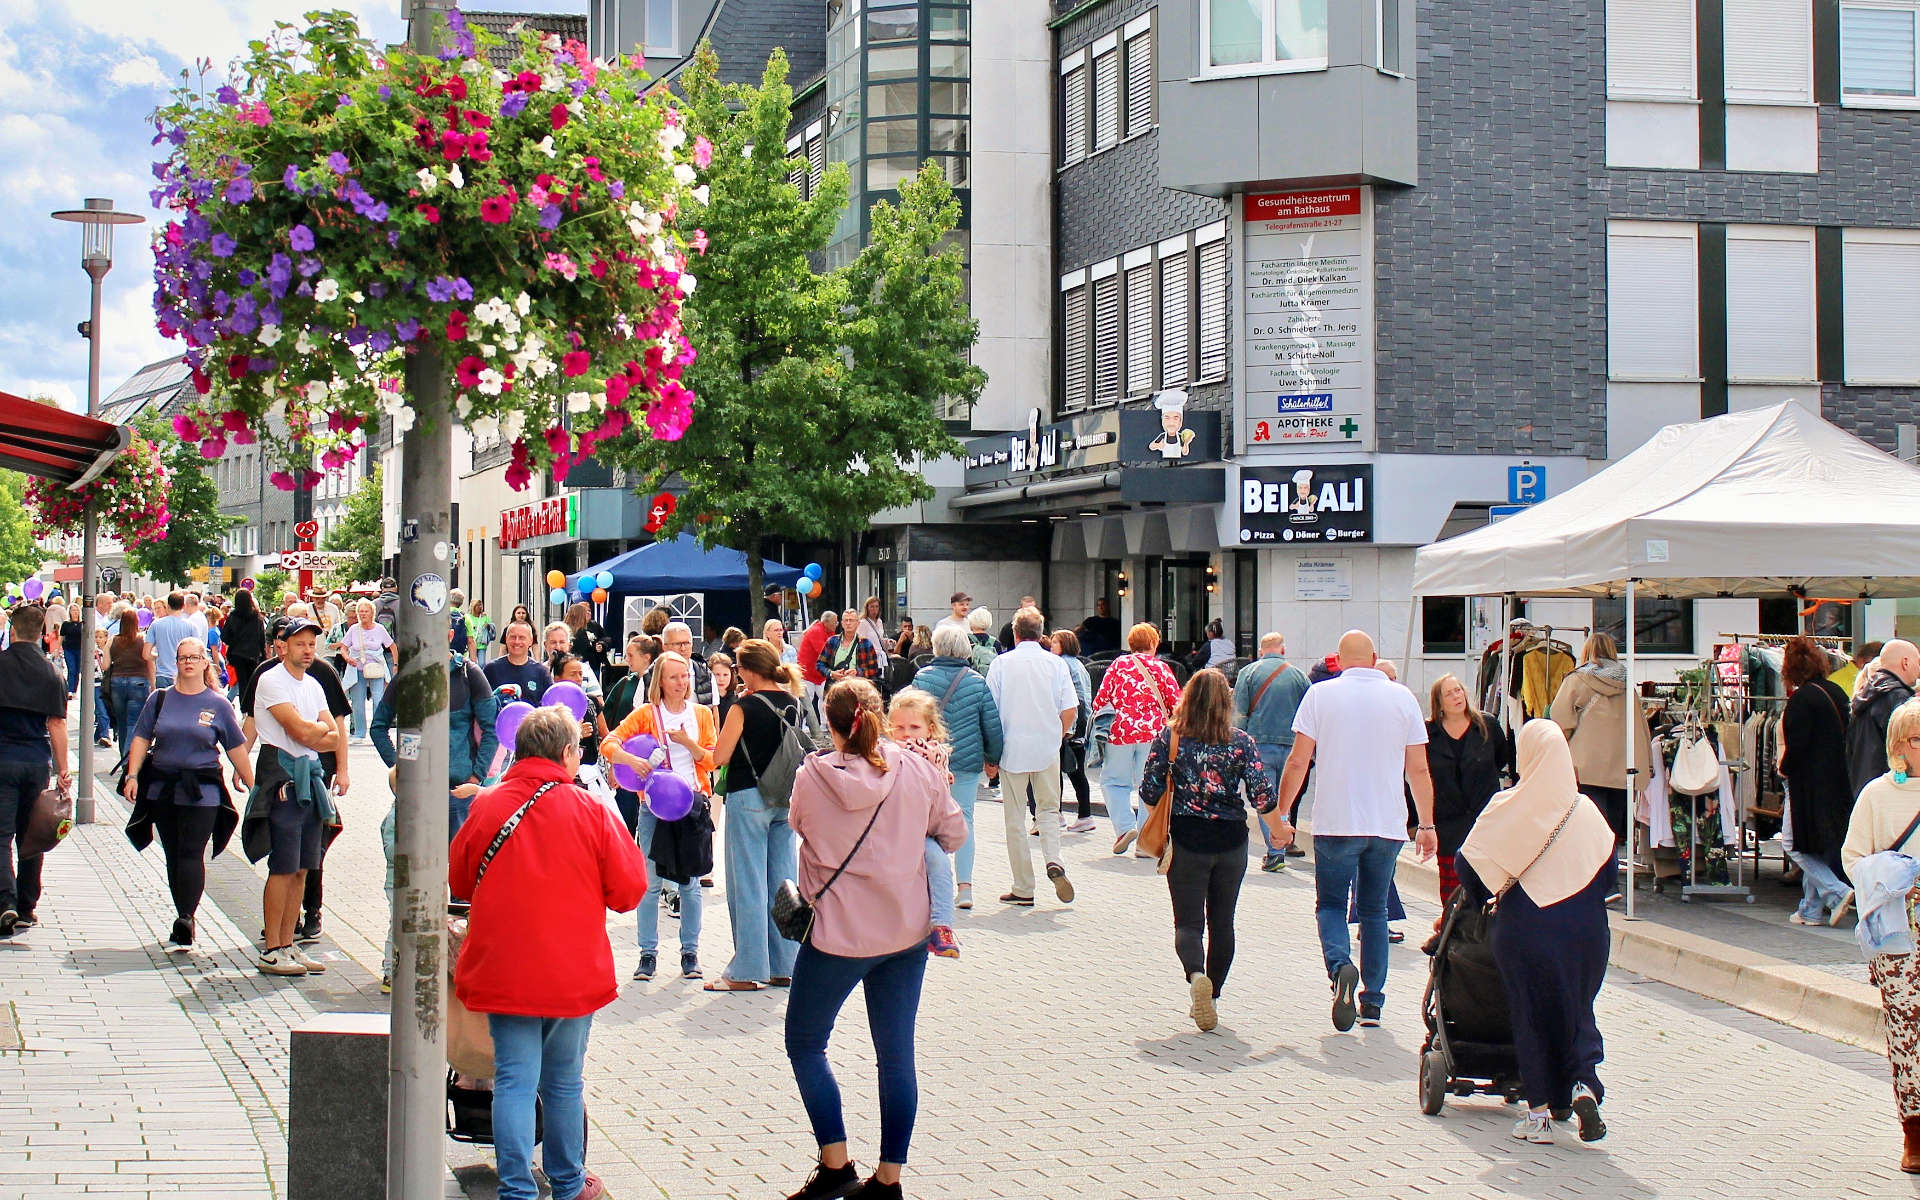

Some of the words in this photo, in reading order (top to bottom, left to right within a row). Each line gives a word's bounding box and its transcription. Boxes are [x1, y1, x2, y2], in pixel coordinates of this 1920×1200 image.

[1257, 194, 1350, 207] Gesundheitszentrum
[1277, 208, 1292, 216] am
[1294, 205, 1331, 215] Rathaus
[1265, 221, 1322, 231] Telegrafenstraße
[1324, 219, 1342, 227] 21-27
[1262, 277, 1274, 286] Dr.
[1297, 275, 1318, 284] Dilek
[1319, 274, 1347, 283] Kalkan
[1279, 300, 1299, 308] Jutta
[1253, 327, 1265, 335] Dr.
[1323, 324, 1336, 332] Th.
[1326, 341, 1356, 350] Massage
[1274, 352, 1285, 361] M.
[1279, 379, 1297, 387] Uwe
[1299, 377, 1331, 386] Schmidt
[1277, 417, 1333, 429] APOTHEKE
[1282, 431, 1292, 439] an
[1309, 428, 1328, 438] Post
[1011, 436, 1026, 472] BEI
[1516, 470, 1537, 500] P
[1243, 479, 1289, 514] BEI
[1316, 477, 1364, 512] ALI
[1253, 531, 1275, 540] Pizza
[1295, 530, 1321, 539] Döner
[1337, 529, 1365, 540] Burger
[212, 554, 221, 566] P
